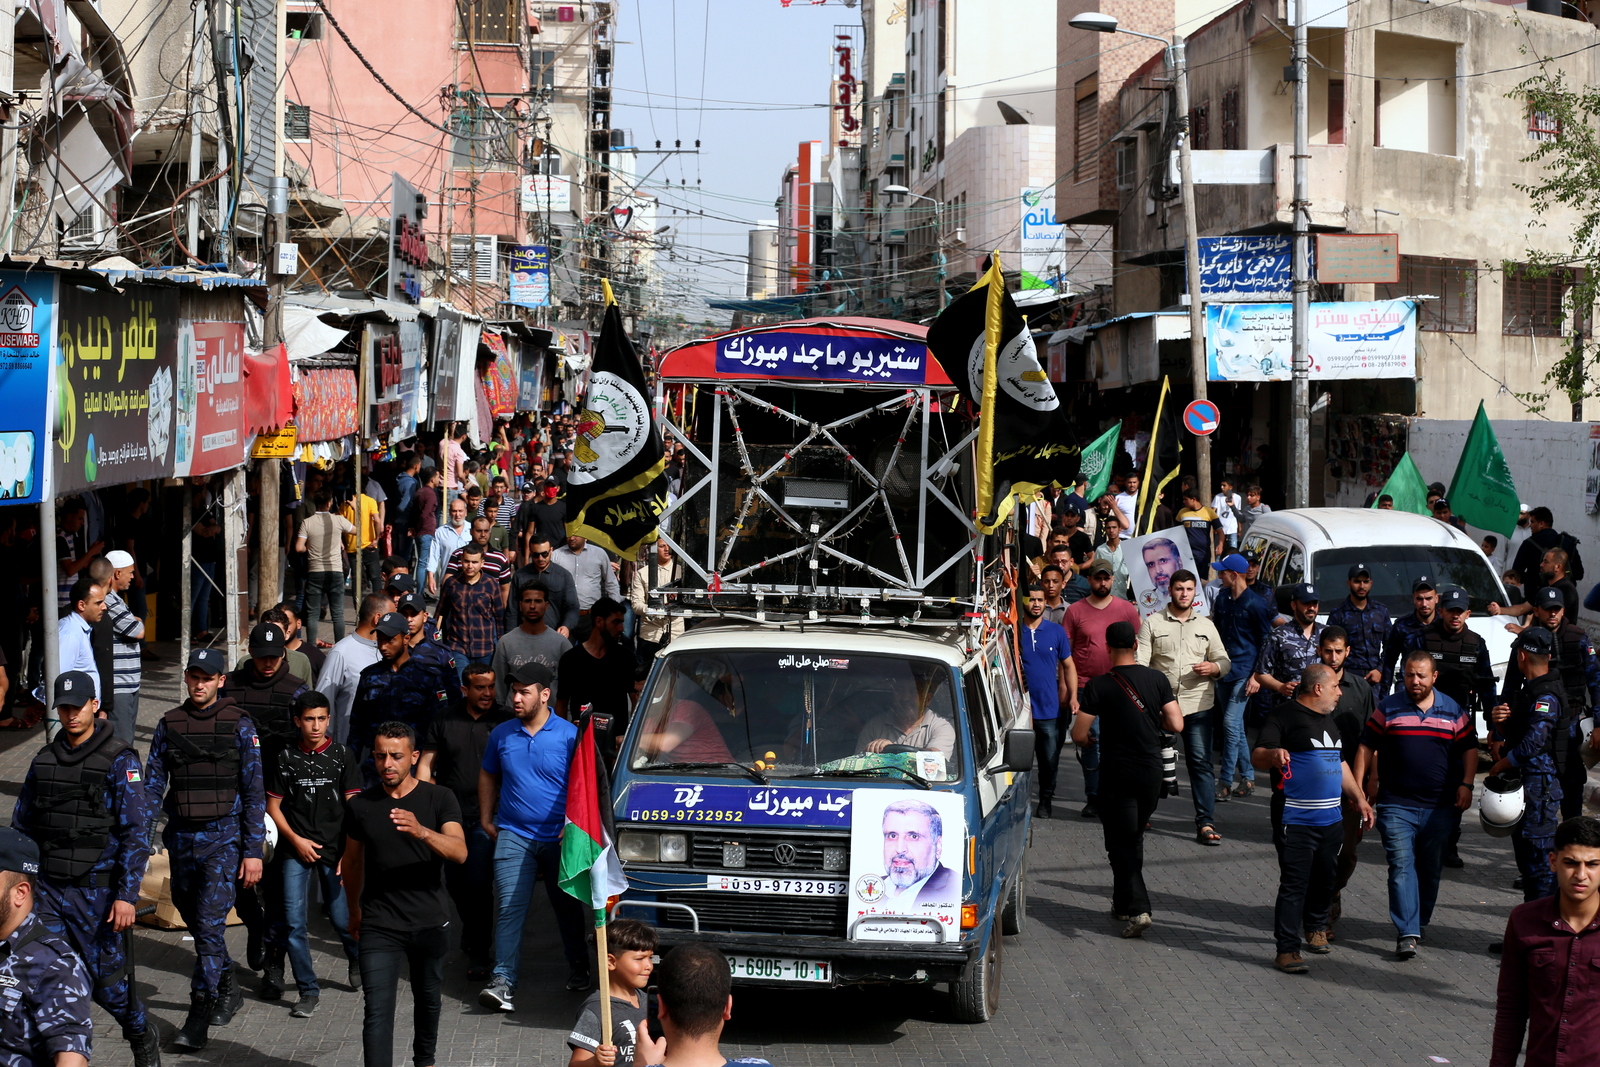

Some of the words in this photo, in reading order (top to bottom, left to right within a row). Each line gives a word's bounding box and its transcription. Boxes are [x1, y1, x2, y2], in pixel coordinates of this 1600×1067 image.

[77, 316, 112, 380] ديب
[118, 298, 157, 383] ظافر
[723, 336, 788, 369] ميوزك
[792, 343, 847, 371] ماجد
[848, 346, 920, 378] ستيريو
[778, 654, 795, 669] النبي
[795, 655, 811, 668] على
[812, 655, 830, 671] صلي
[748, 788, 814, 817] ميوزك
[818, 793, 850, 818] جد
[641, 809, 743, 822] 059-9732952
[732, 878, 847, 895] 059-9732952
[620, 1046, 635, 1056] VE
